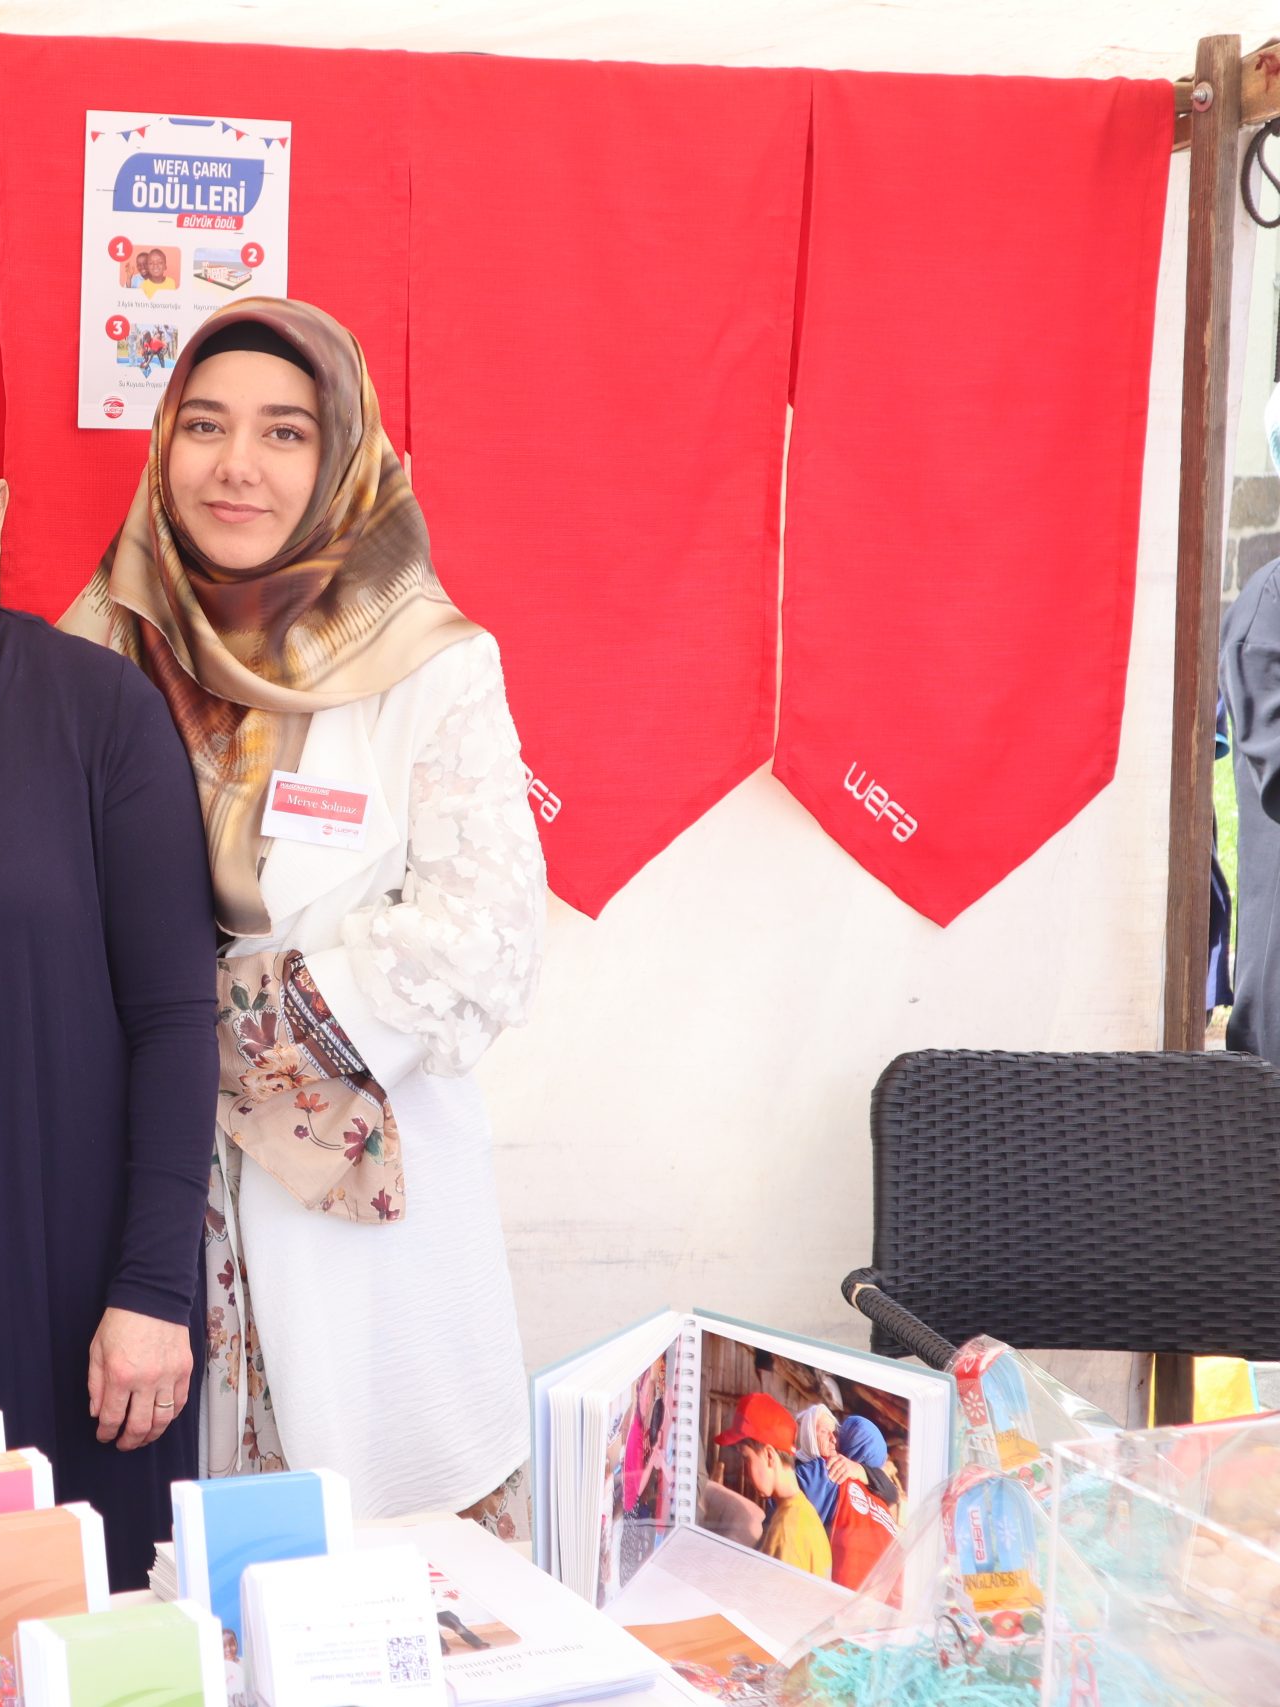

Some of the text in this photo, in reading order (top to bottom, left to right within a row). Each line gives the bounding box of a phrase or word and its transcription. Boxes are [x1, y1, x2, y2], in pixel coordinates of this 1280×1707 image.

[153, 159, 231, 180] WEFA ÇARKI
[132, 175, 246, 213] ÖDÜLLERİ
[183, 214, 238, 230] BÜYÜK ÖDÜL
[116, 242, 125, 257] 1
[248, 247, 258, 262] 2
[113, 320, 123, 335] 3
[287, 793, 359, 815] Merve Solmaz
[524, 768, 562, 823] fa
[843, 761, 919, 843] wefa
[970, 1510, 986, 1561] wefa
[963, 1570, 1024, 1591] ANGLADESH
